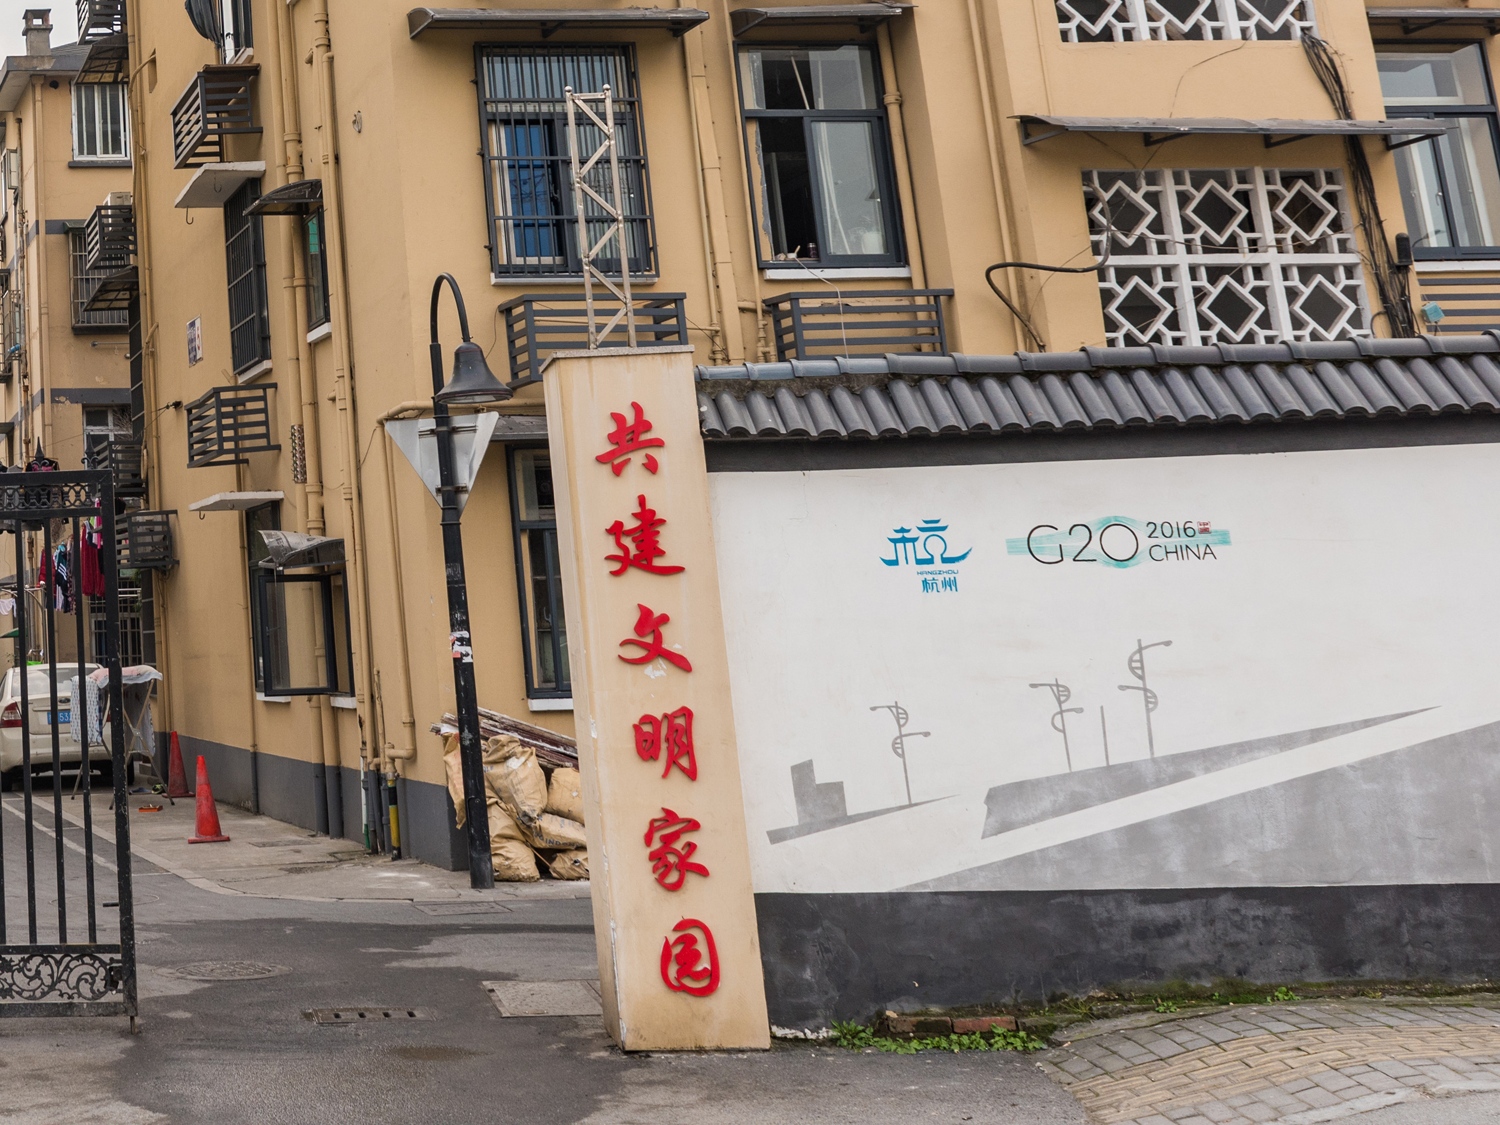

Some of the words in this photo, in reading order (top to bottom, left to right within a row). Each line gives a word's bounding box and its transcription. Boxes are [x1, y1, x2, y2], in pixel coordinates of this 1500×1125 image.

[1026, 523, 1139, 565] G20
[1146, 520, 1197, 539] 2016
[1148, 543, 1217, 562] CHINA
[921, 576, 959, 593] 杭州
[595, 401, 721, 997] 共建文明家园
